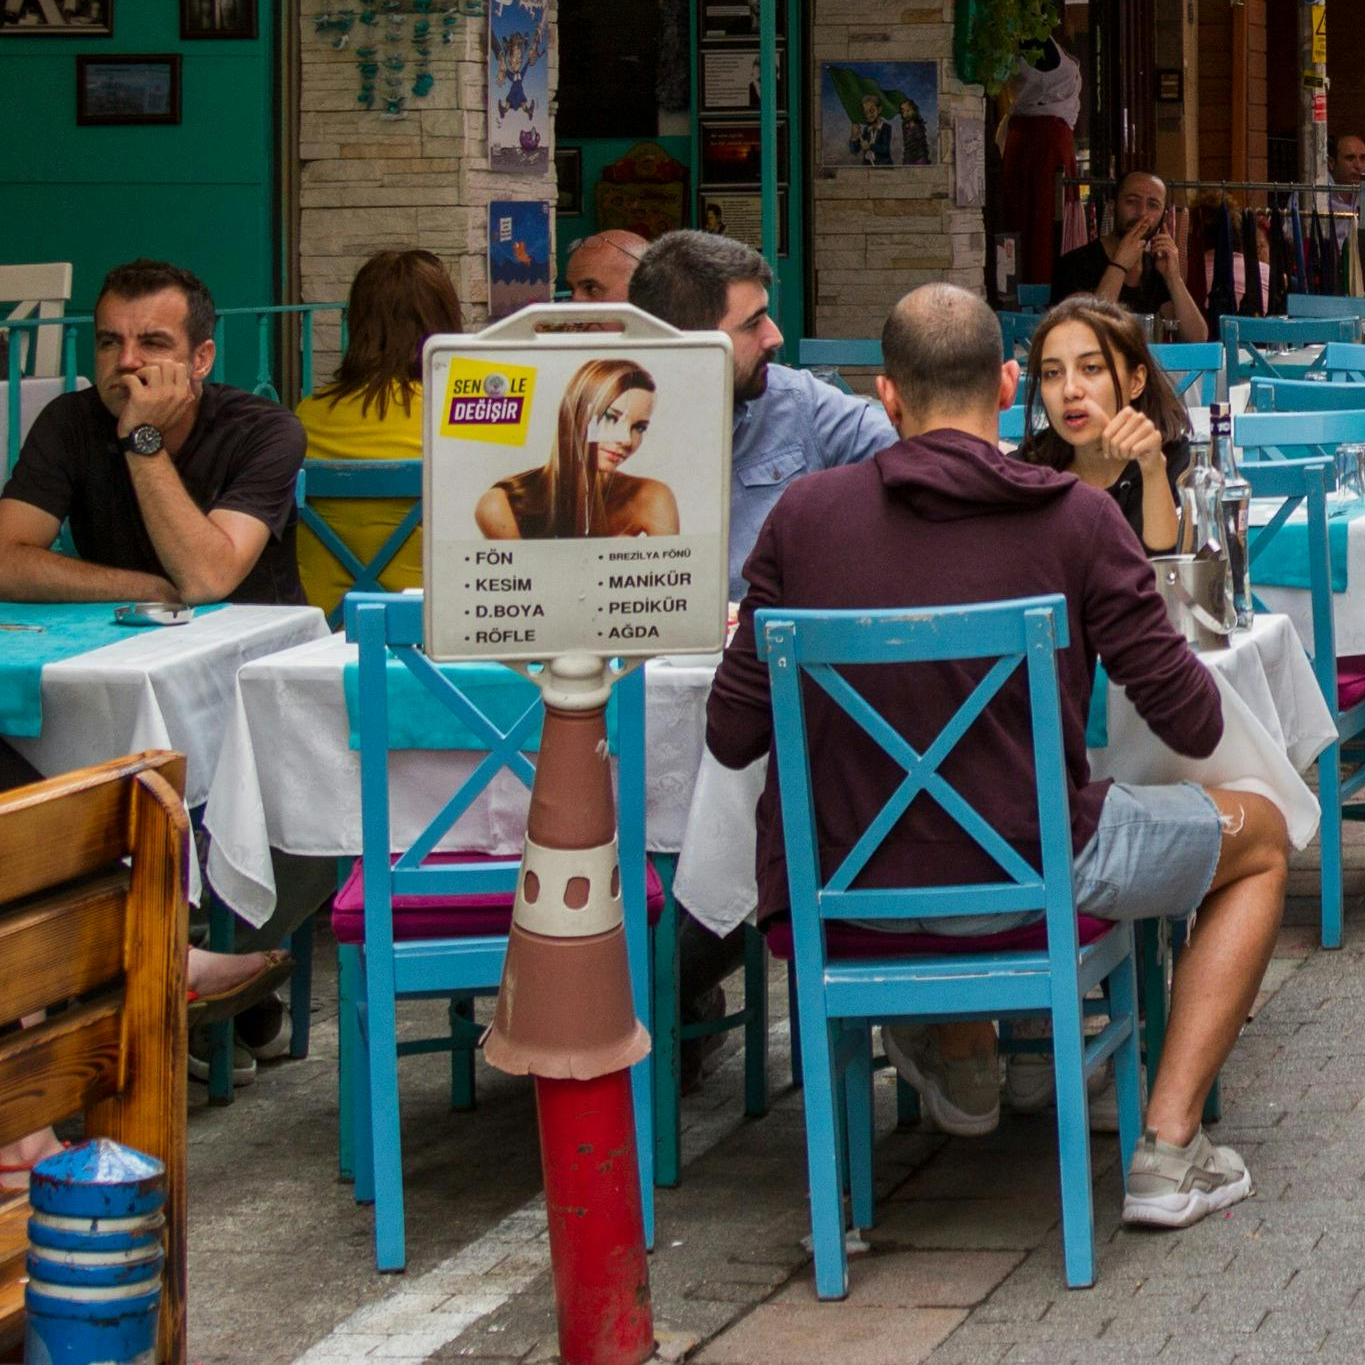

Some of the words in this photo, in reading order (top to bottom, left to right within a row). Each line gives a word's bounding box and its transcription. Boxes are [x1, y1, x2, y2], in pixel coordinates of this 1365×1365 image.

[453, 379, 481, 394] SEN
[511, 378, 527, 393] LE
[454, 399, 518, 422] DEĞİŞİR
[475, 550, 513, 565] FÖN
[609, 550, 660, 561] BREZİLYA
[663, 548, 691, 560] FÖNÜ
[475, 576, 532, 592] KESİM
[609, 571, 692, 588] MANİKÜR
[475, 604, 545, 618] D.BOYA
[609, 597, 687, 614] PEDİKÜR
[475, 628, 536, 644] RÖFLE
[609, 623, 660, 639] AĞDA
